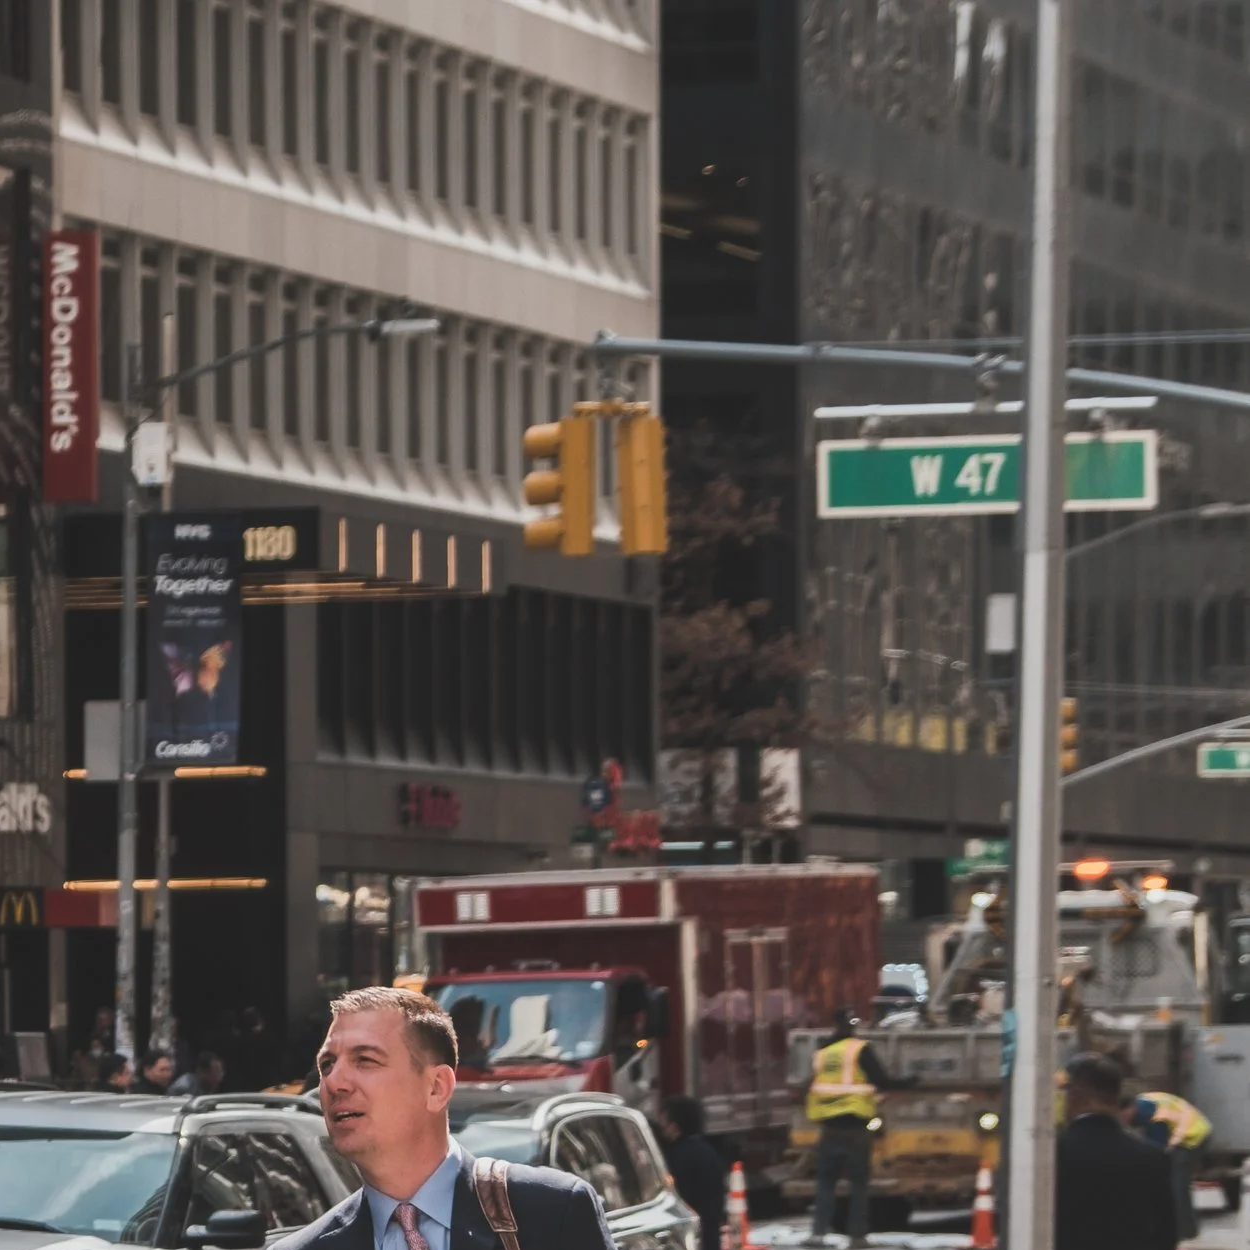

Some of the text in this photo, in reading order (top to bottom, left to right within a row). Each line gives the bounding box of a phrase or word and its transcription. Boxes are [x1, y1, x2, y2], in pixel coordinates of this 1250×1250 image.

[50, 241, 80, 454] McDonald's
[910, 453, 1007, 498] W 47
[154, 575, 233, 598] Together
